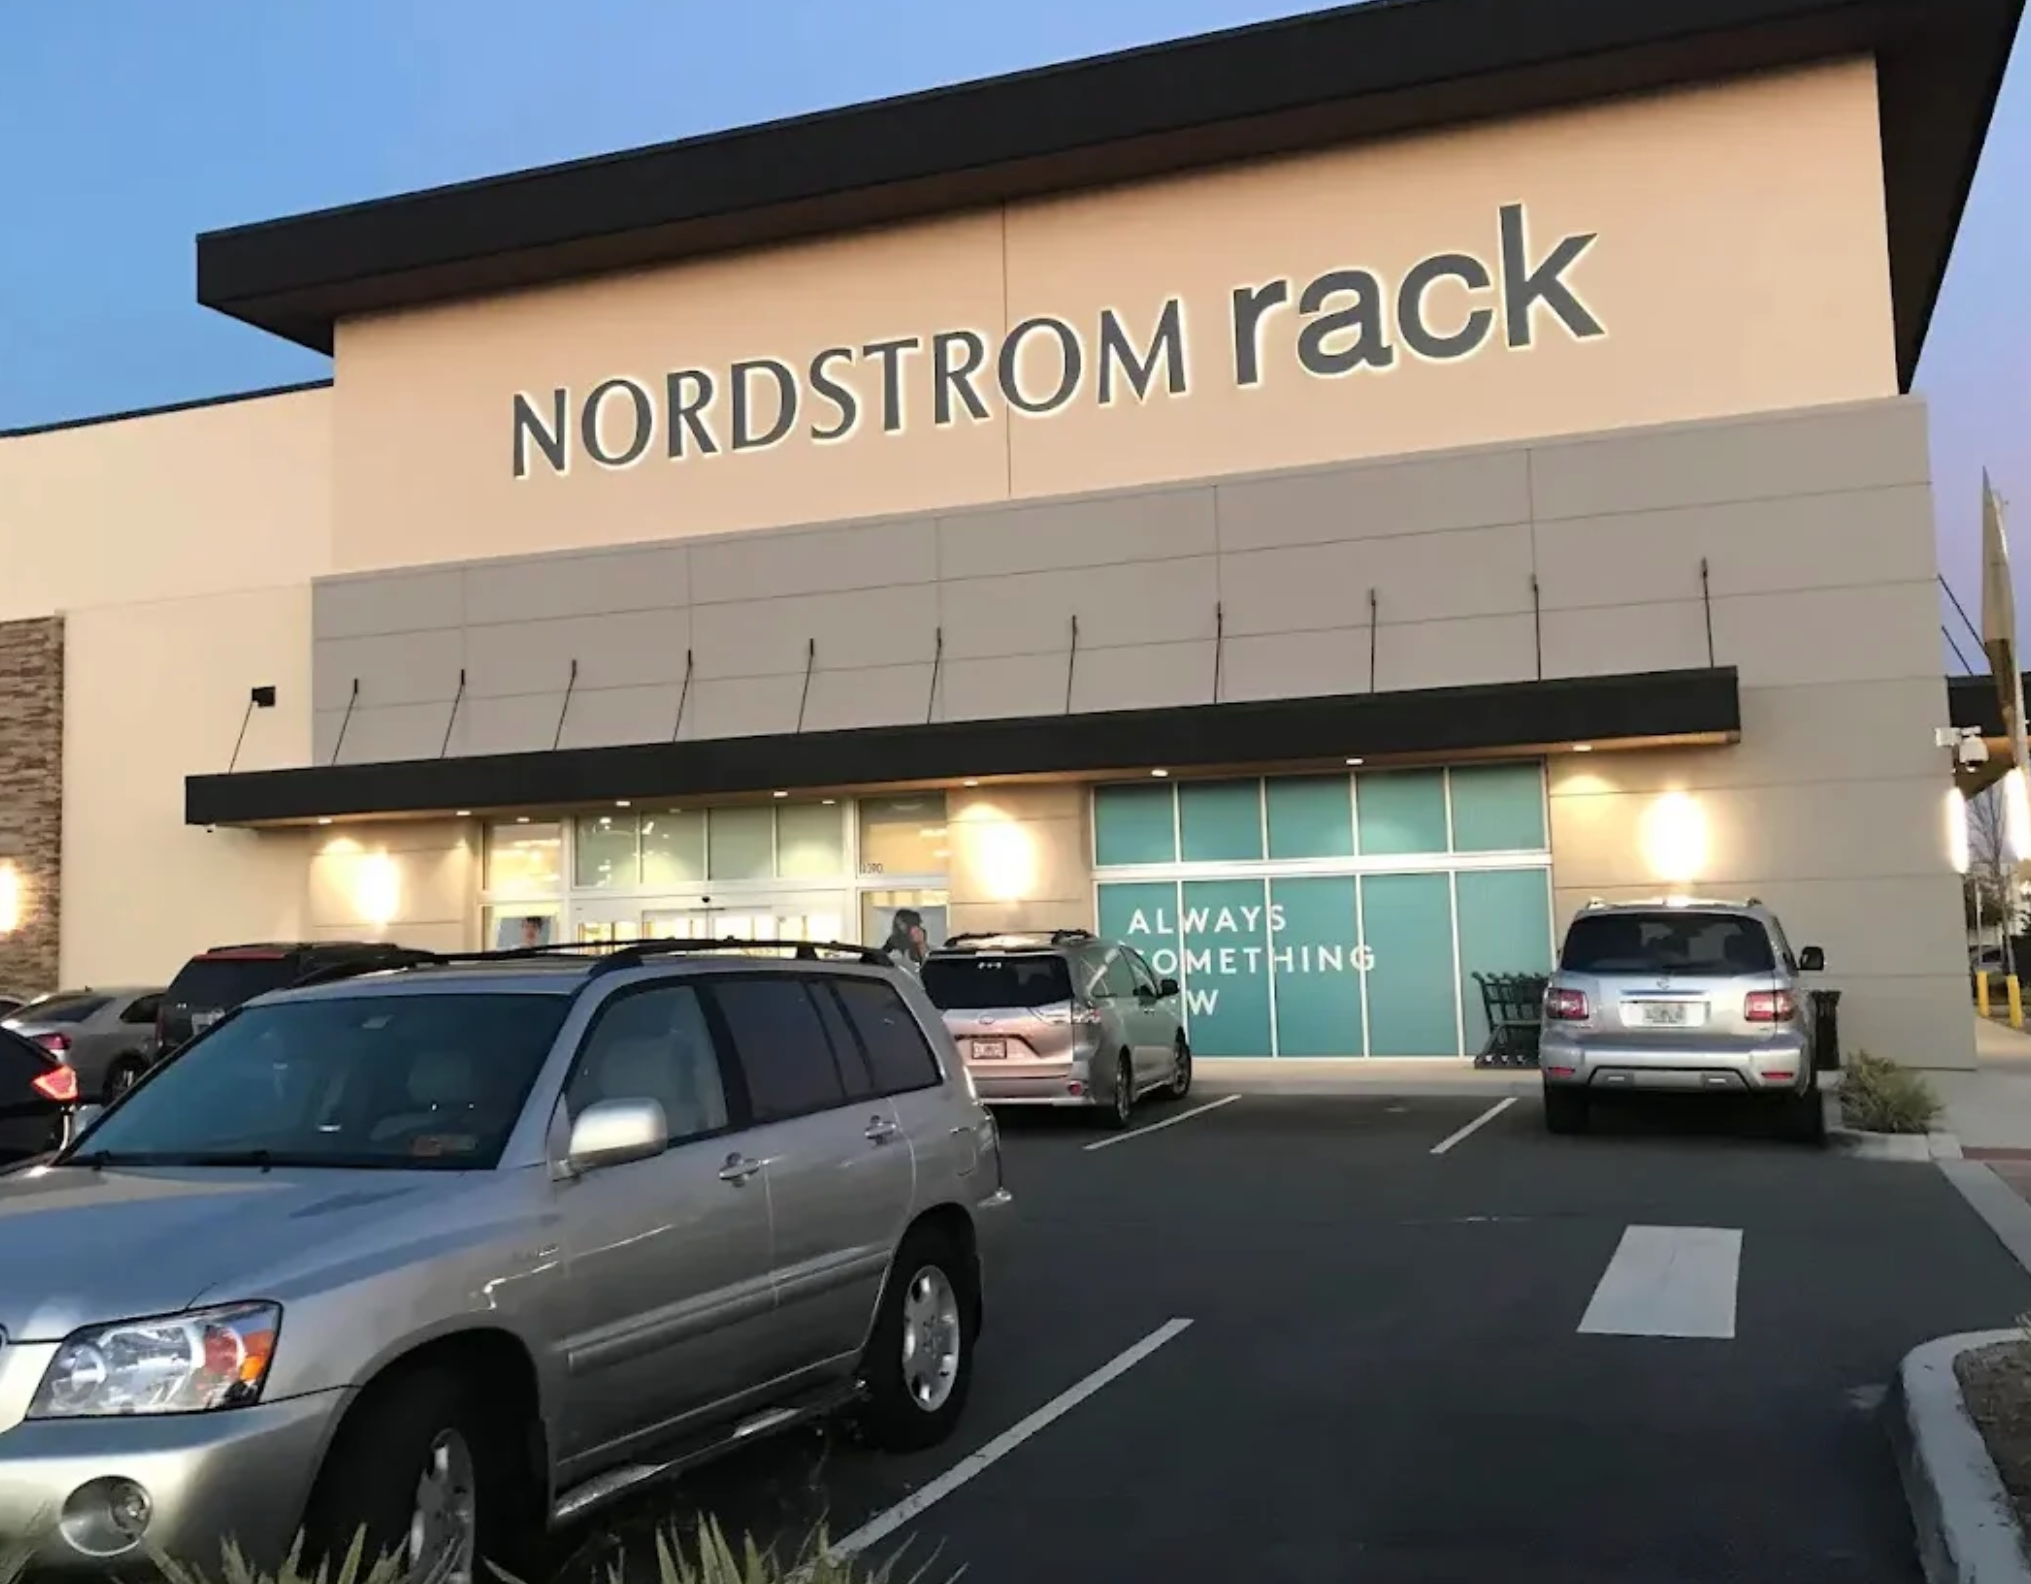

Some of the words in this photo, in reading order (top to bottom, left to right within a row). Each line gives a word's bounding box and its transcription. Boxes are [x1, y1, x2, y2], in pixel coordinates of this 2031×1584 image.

[513, 299, 1187, 477] NORDSTROM
[1232, 203, 1604, 386] rack
[1127, 904, 1287, 935] ALWAYS
[1135, 944, 1376, 975] OMETHING
